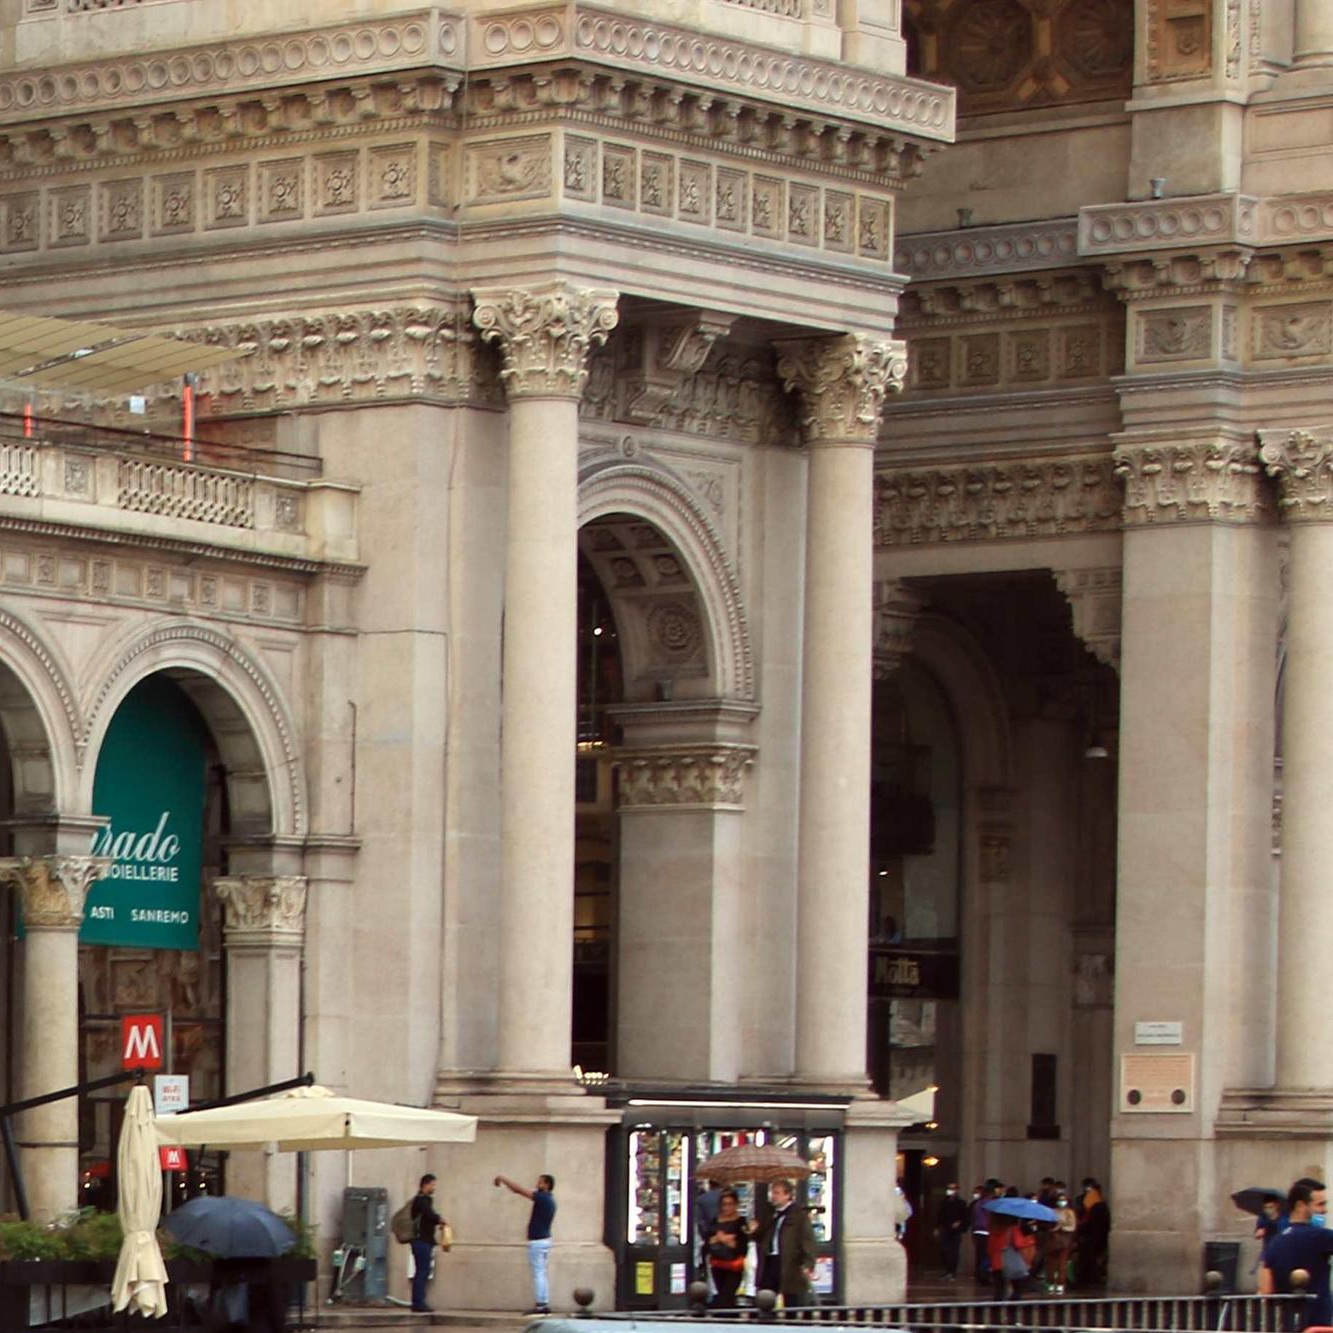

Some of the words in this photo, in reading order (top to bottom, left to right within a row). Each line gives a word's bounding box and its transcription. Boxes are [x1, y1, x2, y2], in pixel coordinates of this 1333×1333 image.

[90, 906, 115, 919] ASTI
[130, 908, 190, 924] SANREMO
[124, 1024, 160, 1059] M
